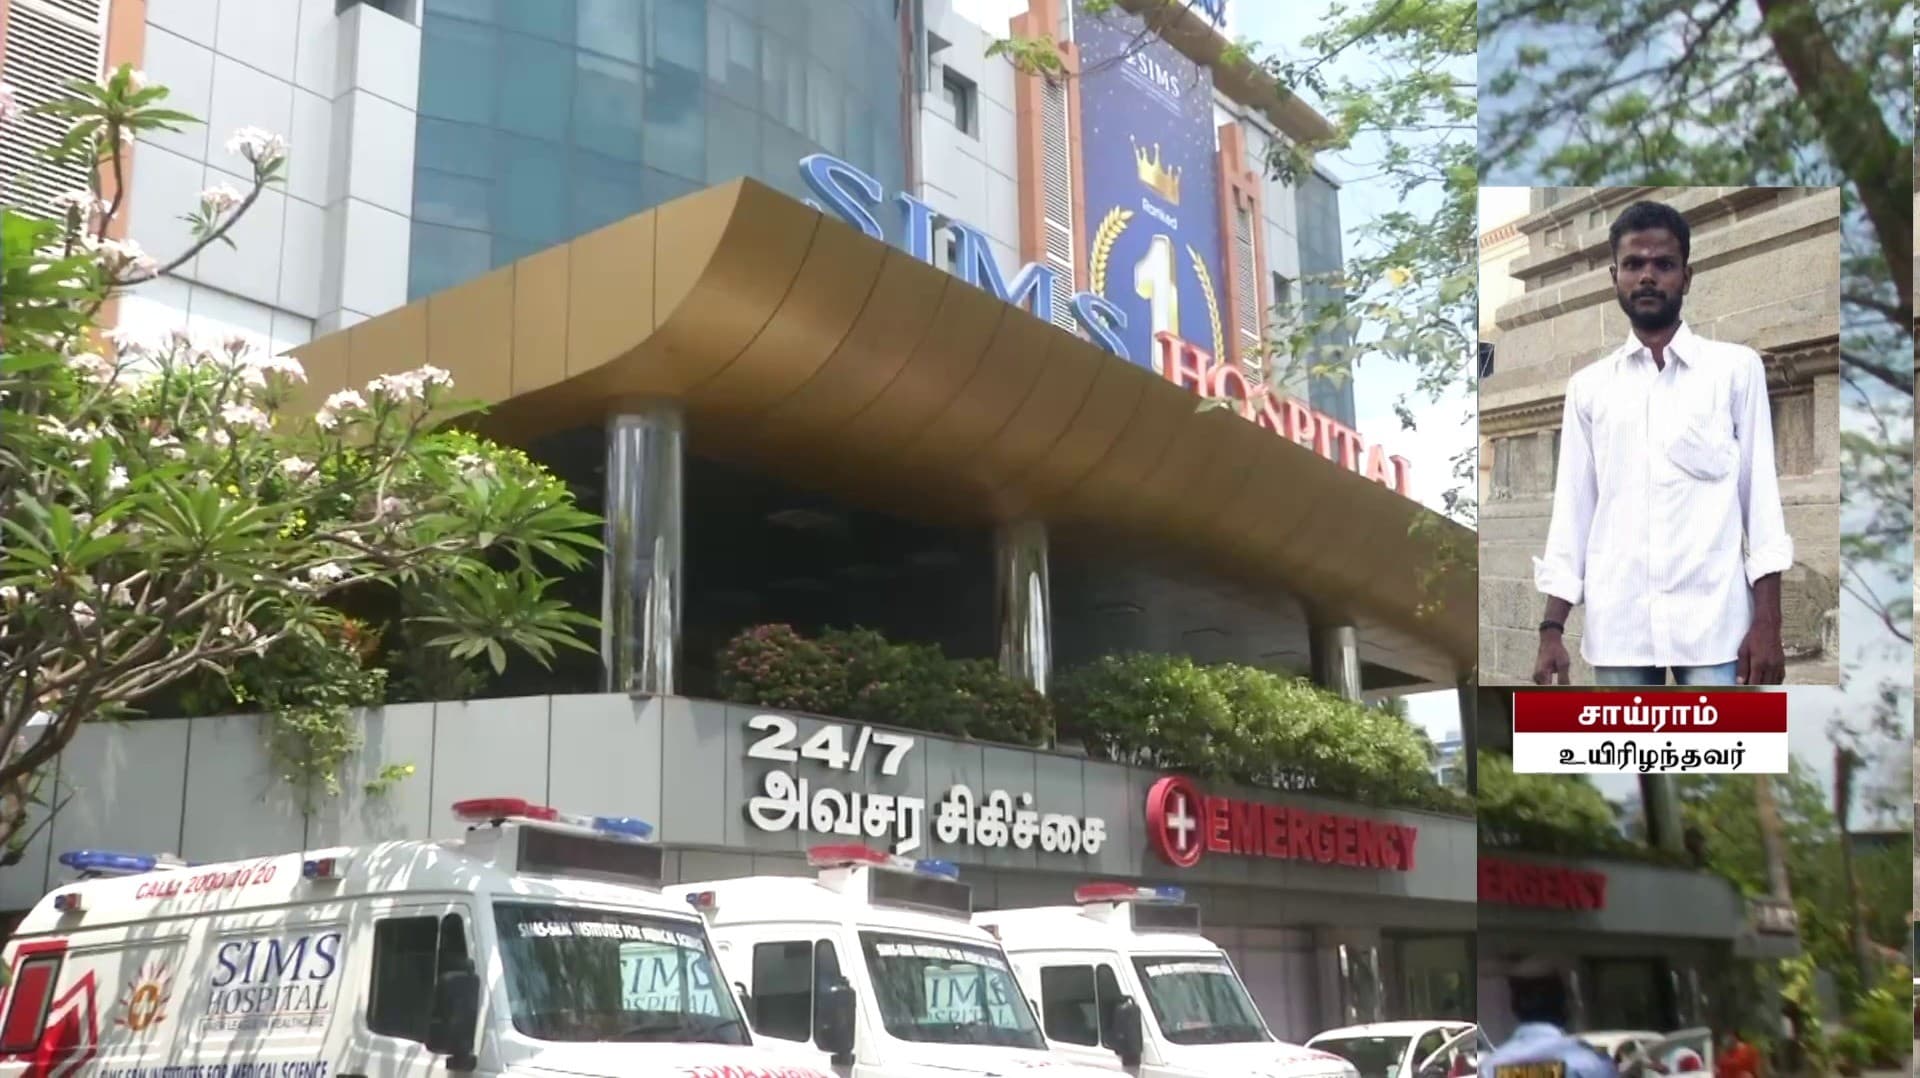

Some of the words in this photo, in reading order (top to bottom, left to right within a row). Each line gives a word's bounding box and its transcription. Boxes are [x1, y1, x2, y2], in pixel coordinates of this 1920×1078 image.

[1137, 52, 1180, 98] SIMS
[1141, 197, 1178, 230] Ranked
[799, 152, 1131, 361] SIMS
[1134, 233, 1178, 373] 1
[748, 714, 914, 776] 24/7
[749, 770, 926, 856] அவசர
[936, 783, 1107, 855] சிகிச்சை
[1204, 795, 1417, 872] EMERGENCY
[211, 933, 342, 987] SIMS
[206, 983, 330, 1015] HOSPITAL
